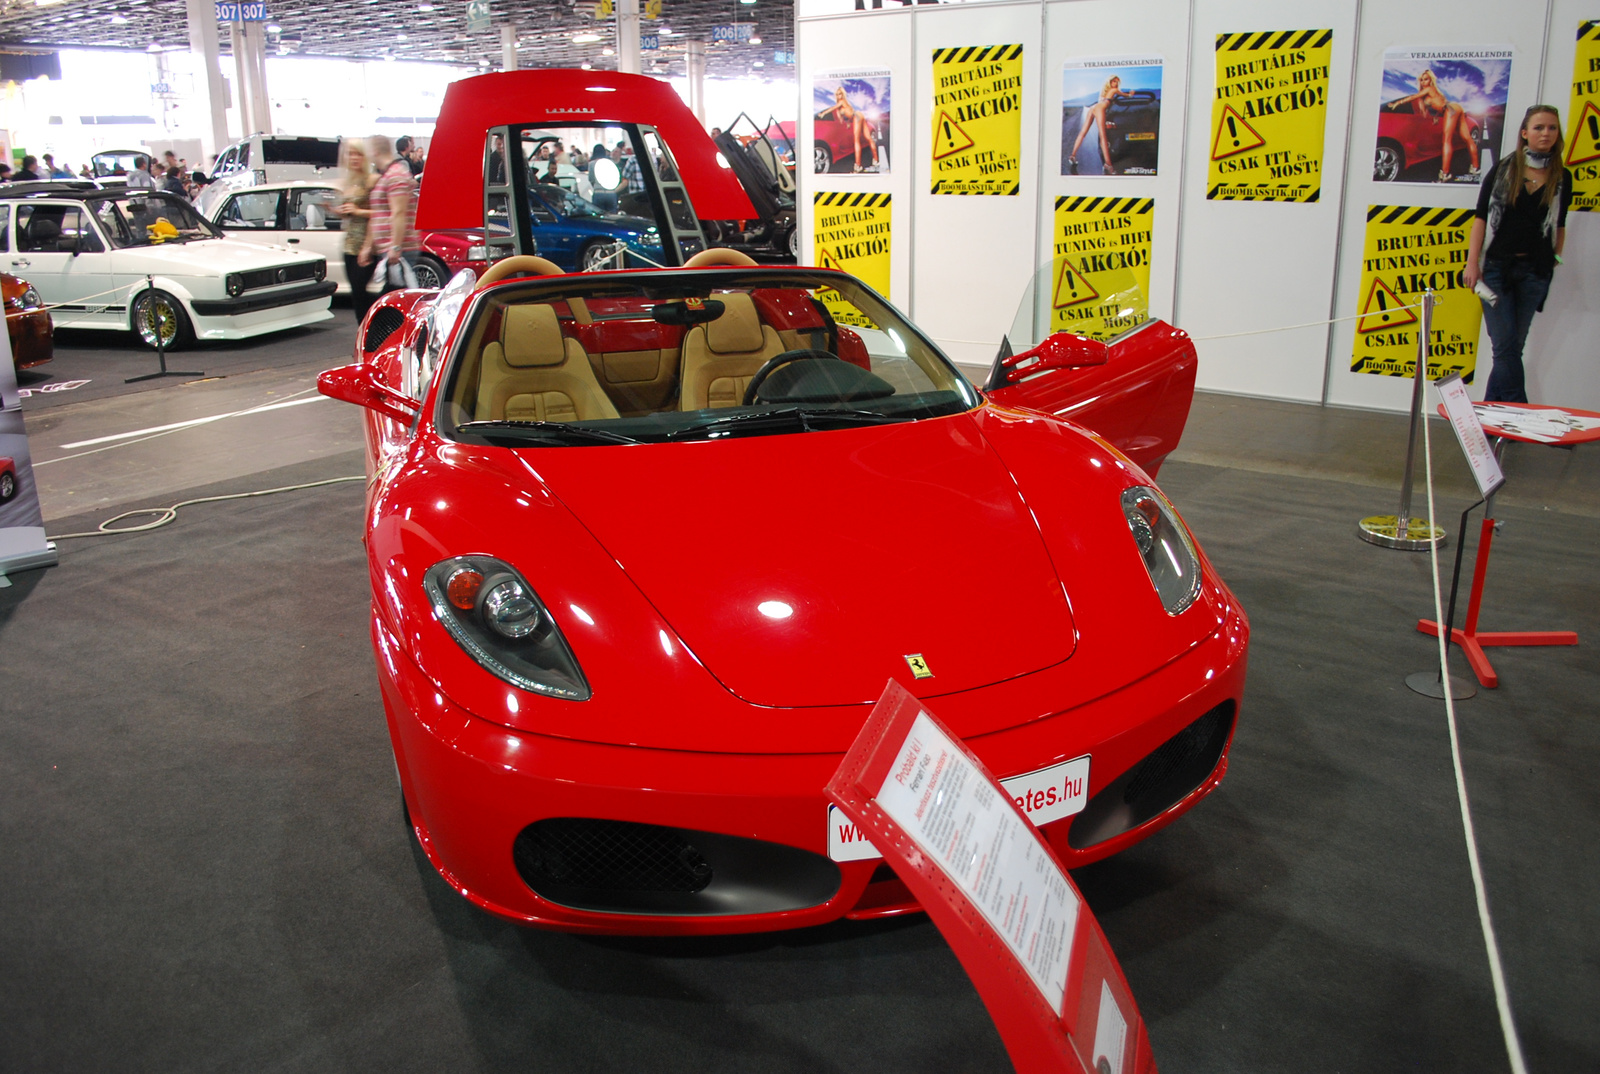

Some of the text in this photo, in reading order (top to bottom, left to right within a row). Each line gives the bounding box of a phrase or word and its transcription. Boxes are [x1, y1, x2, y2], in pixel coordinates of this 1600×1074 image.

[243, 4, 264, 19] 307
[714, 27, 734, 39] 206
[1084, 59, 1163, 68] VERJAARDAGSKALENDER
[1225, 50, 1306, 78] BRUTÁLIS
[940, 62, 1003, 88] BRUTÁLIS
[1216, 66, 1328, 100] TUNING ÉS HIFI
[934, 86, 980, 106] TUNING
[992, 76, 1022, 92] HIFI
[1242, 84, 1324, 120] AKCIÓ!
[955, 92, 1019, 124] AKCIÓ!
[938, 156, 970, 172] CSAK
[974, 150, 996, 165] ITT
[978, 158, 1018, 176] MOST!
[1218, 150, 1307, 174] CSAK ITT ÉS
[1270, 160, 1319, 180] MOST!
[1220, 187, 1305, 197] BOOMBASSTIK.HU
[821, 209, 875, 228] BRUTÁLIS
[1064, 216, 1132, 236] BRUTÁLIS
[814, 228, 855, 244] TUNING
[866, 222, 890, 236] HIFI
[1054, 236, 1106, 254] TUNING
[1120, 230, 1152, 246] HIFI
[1377, 229, 1465, 252] BRUTÁLIS
[834, 236, 888, 262] AKCIÓ!
[1078, 246, 1148, 274] AKCIÓ!
[1364, 252, 1430, 272] TUNING
[1434, 256, 1446, 264] ÉS
[1060, 304, 1120, 321] CSAK ITT
[1365, 332, 1410, 348] CSAK
[1450, 334, 1462, 342] ÉS
[895, 749, 918, 786] Próbáld
[910, 766, 925, 792] Ferrari
